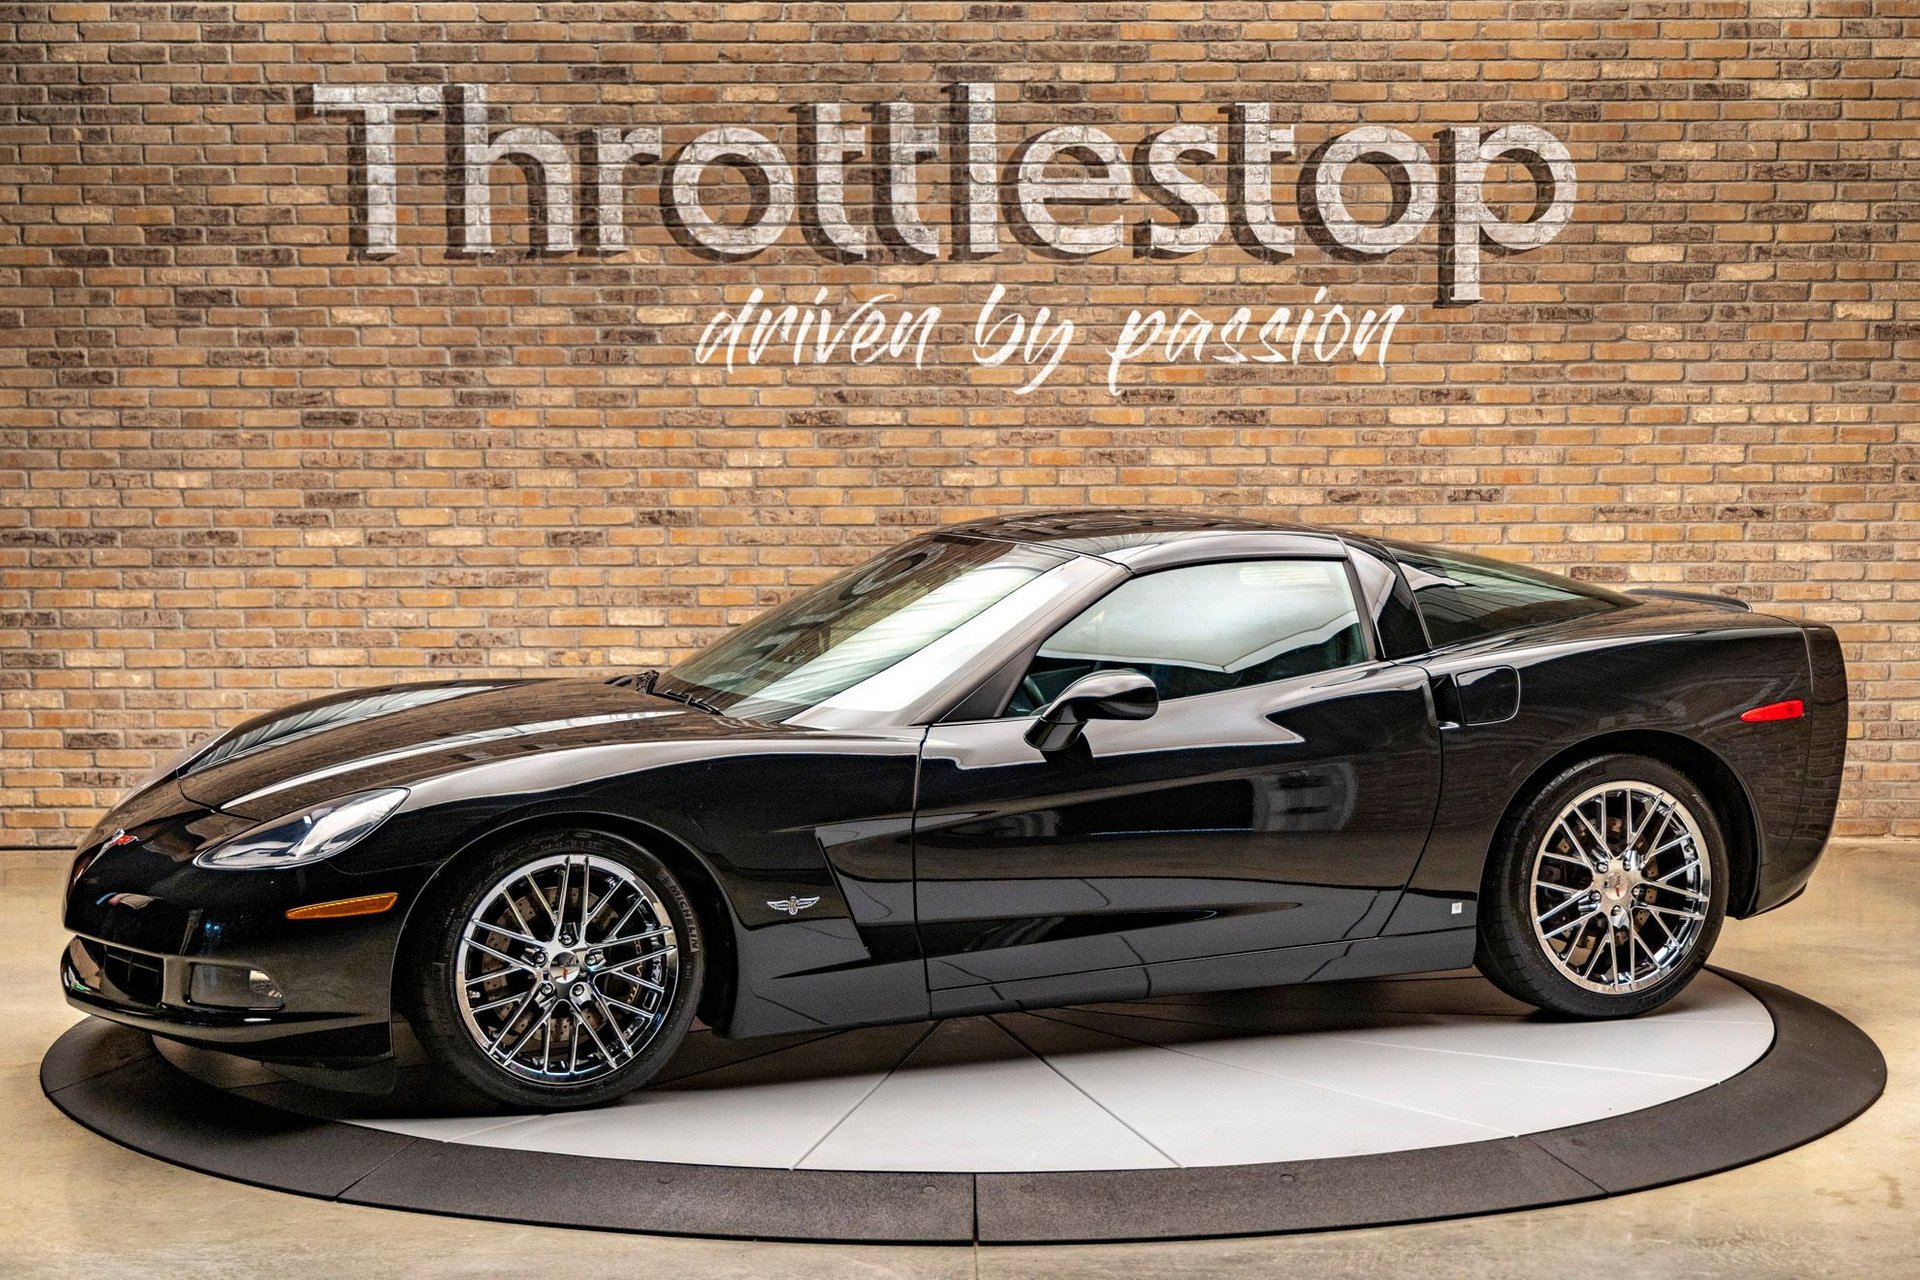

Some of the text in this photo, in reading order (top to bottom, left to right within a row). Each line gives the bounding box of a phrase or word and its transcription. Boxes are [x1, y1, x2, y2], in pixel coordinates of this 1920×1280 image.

[310, 82, 1578, 304] Throttlestop
[694, 284, 1406, 397] driven by passion
[669, 884, 700, 950] MICHELIN
